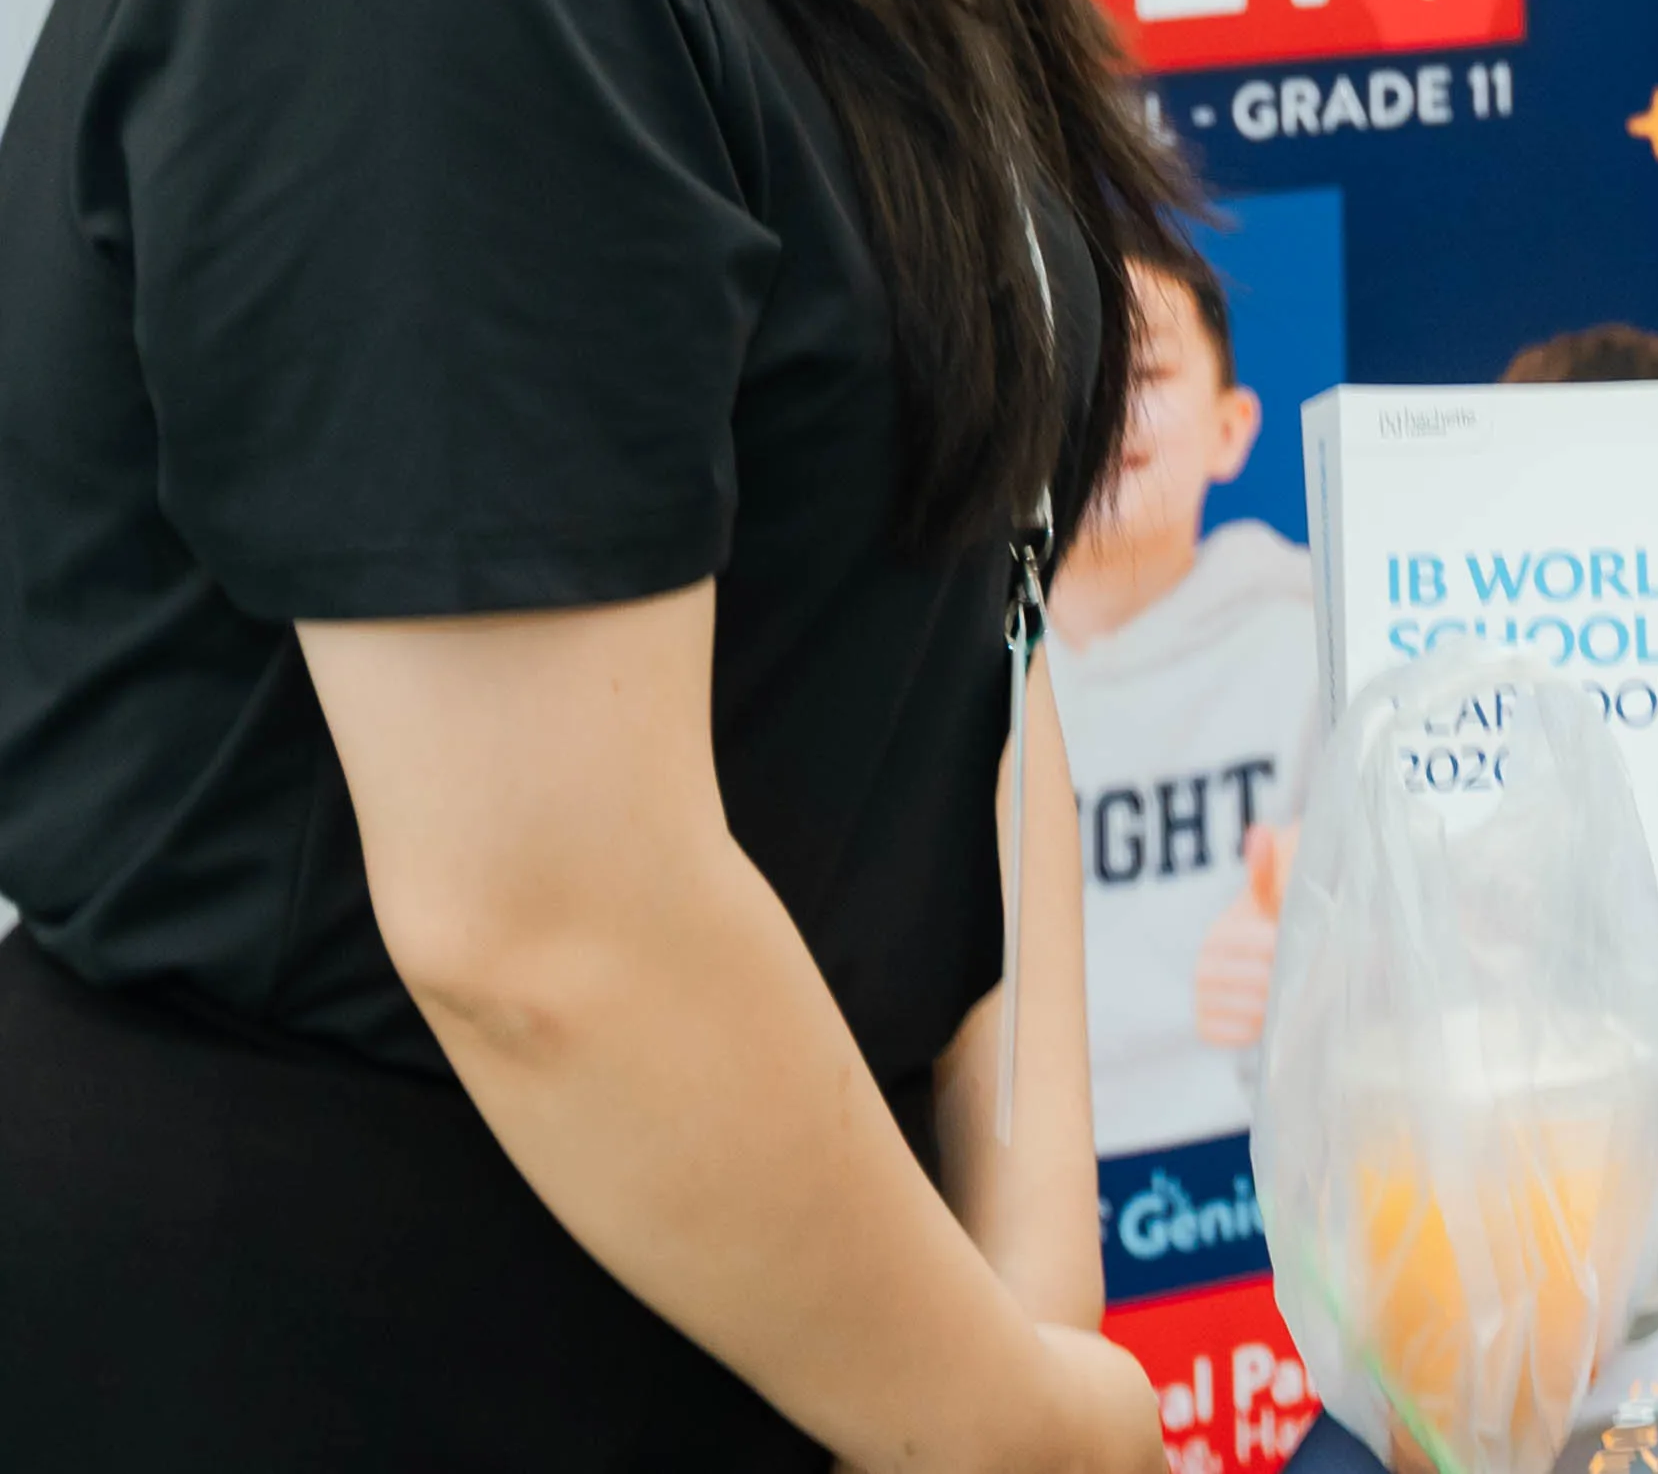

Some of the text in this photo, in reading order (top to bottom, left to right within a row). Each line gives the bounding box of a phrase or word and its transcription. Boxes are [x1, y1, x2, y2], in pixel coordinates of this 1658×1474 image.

[1231, 62, 1455, 142] GRADE
[1466, 59, 1514, 120] 11
[1386, 552, 1448, 606] IB
[1091, 756, 1277, 887] GHT
